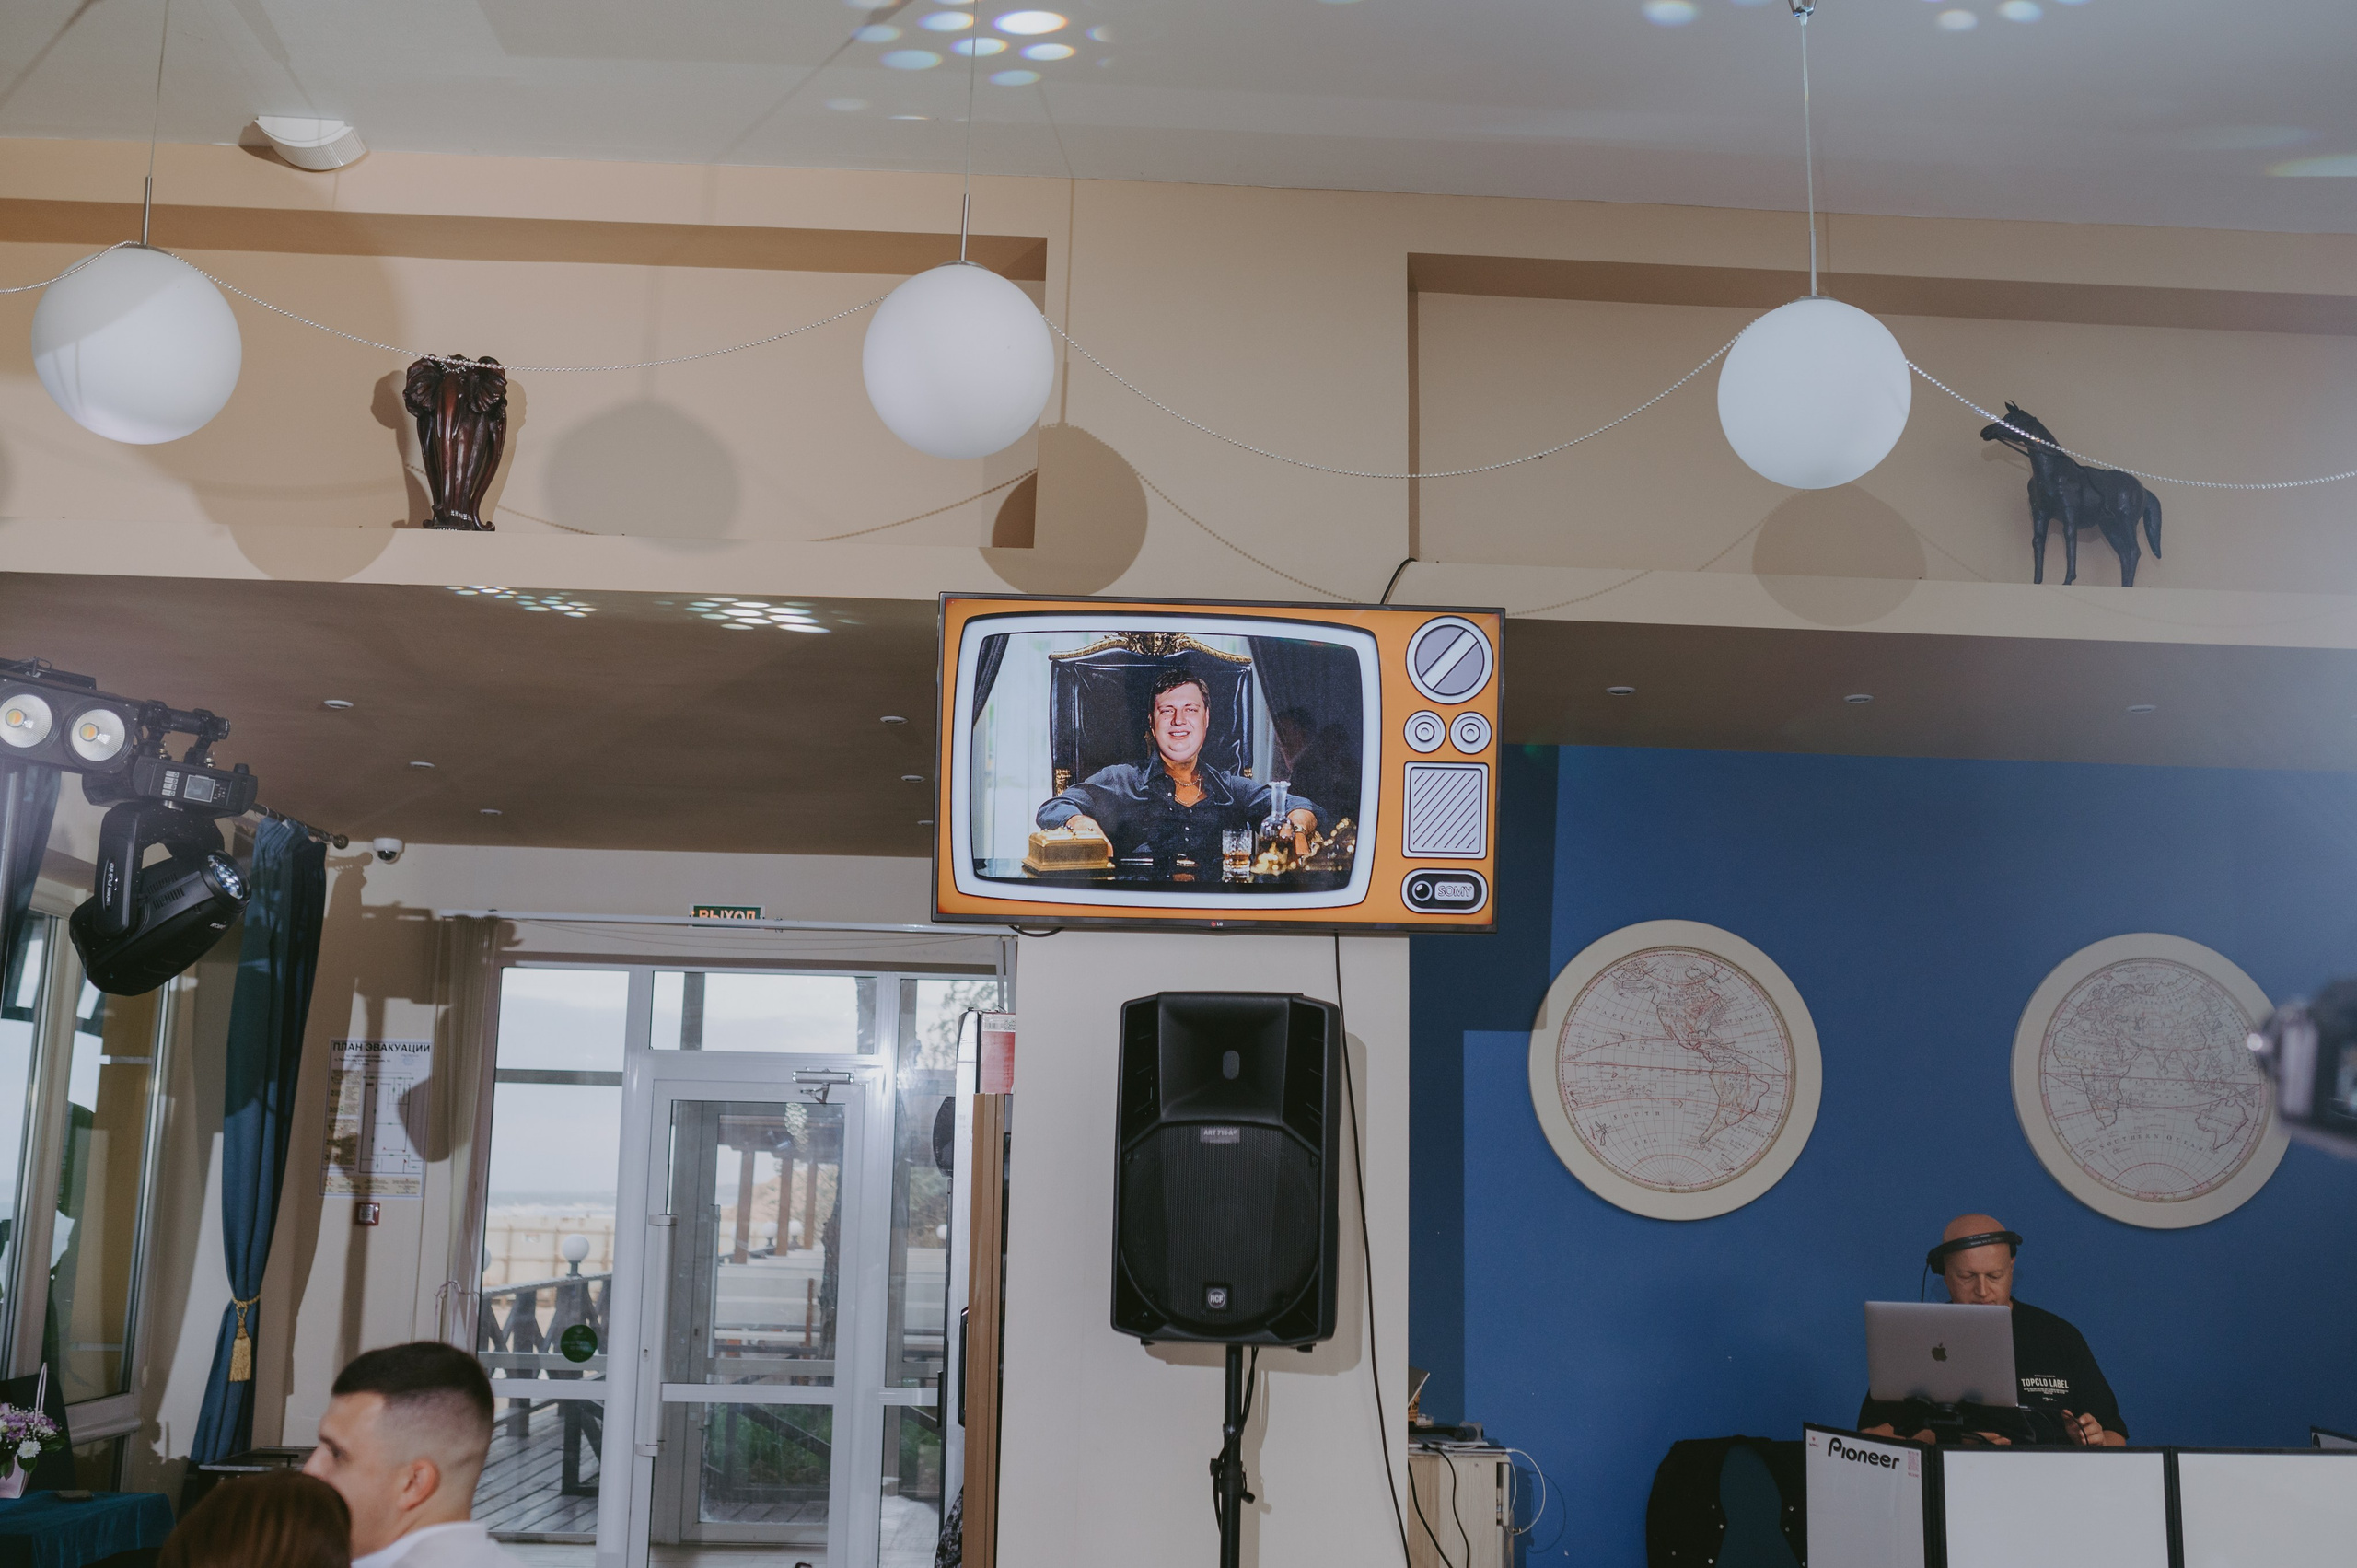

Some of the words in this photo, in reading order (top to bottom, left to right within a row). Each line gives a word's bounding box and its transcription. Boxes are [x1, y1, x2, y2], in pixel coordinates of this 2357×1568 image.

[1437, 885, 1473, 898] SOMY
[1595, 1005, 1651, 1027] PACIFIC
[332, 1042, 363, 1051] ПЛАН
[366, 1042, 430, 1054] ЭВАКУАЦИИ
[1592, 1038, 1646, 1051] OCEAN
[1613, 1111, 1660, 1120] SOUTH
[1634, 1137, 1657, 1146] SEA
[2099, 1133, 2159, 1150] SOUTHERN
[2166, 1134, 2203, 1152] OCEAN
[1210, 1294, 1224, 1304] RCF
[2021, 1377, 2049, 1388] TOPCLO
[2049, 1378, 2070, 1389] LABEL
[1828, 1437, 1900, 1469] Pioneer
